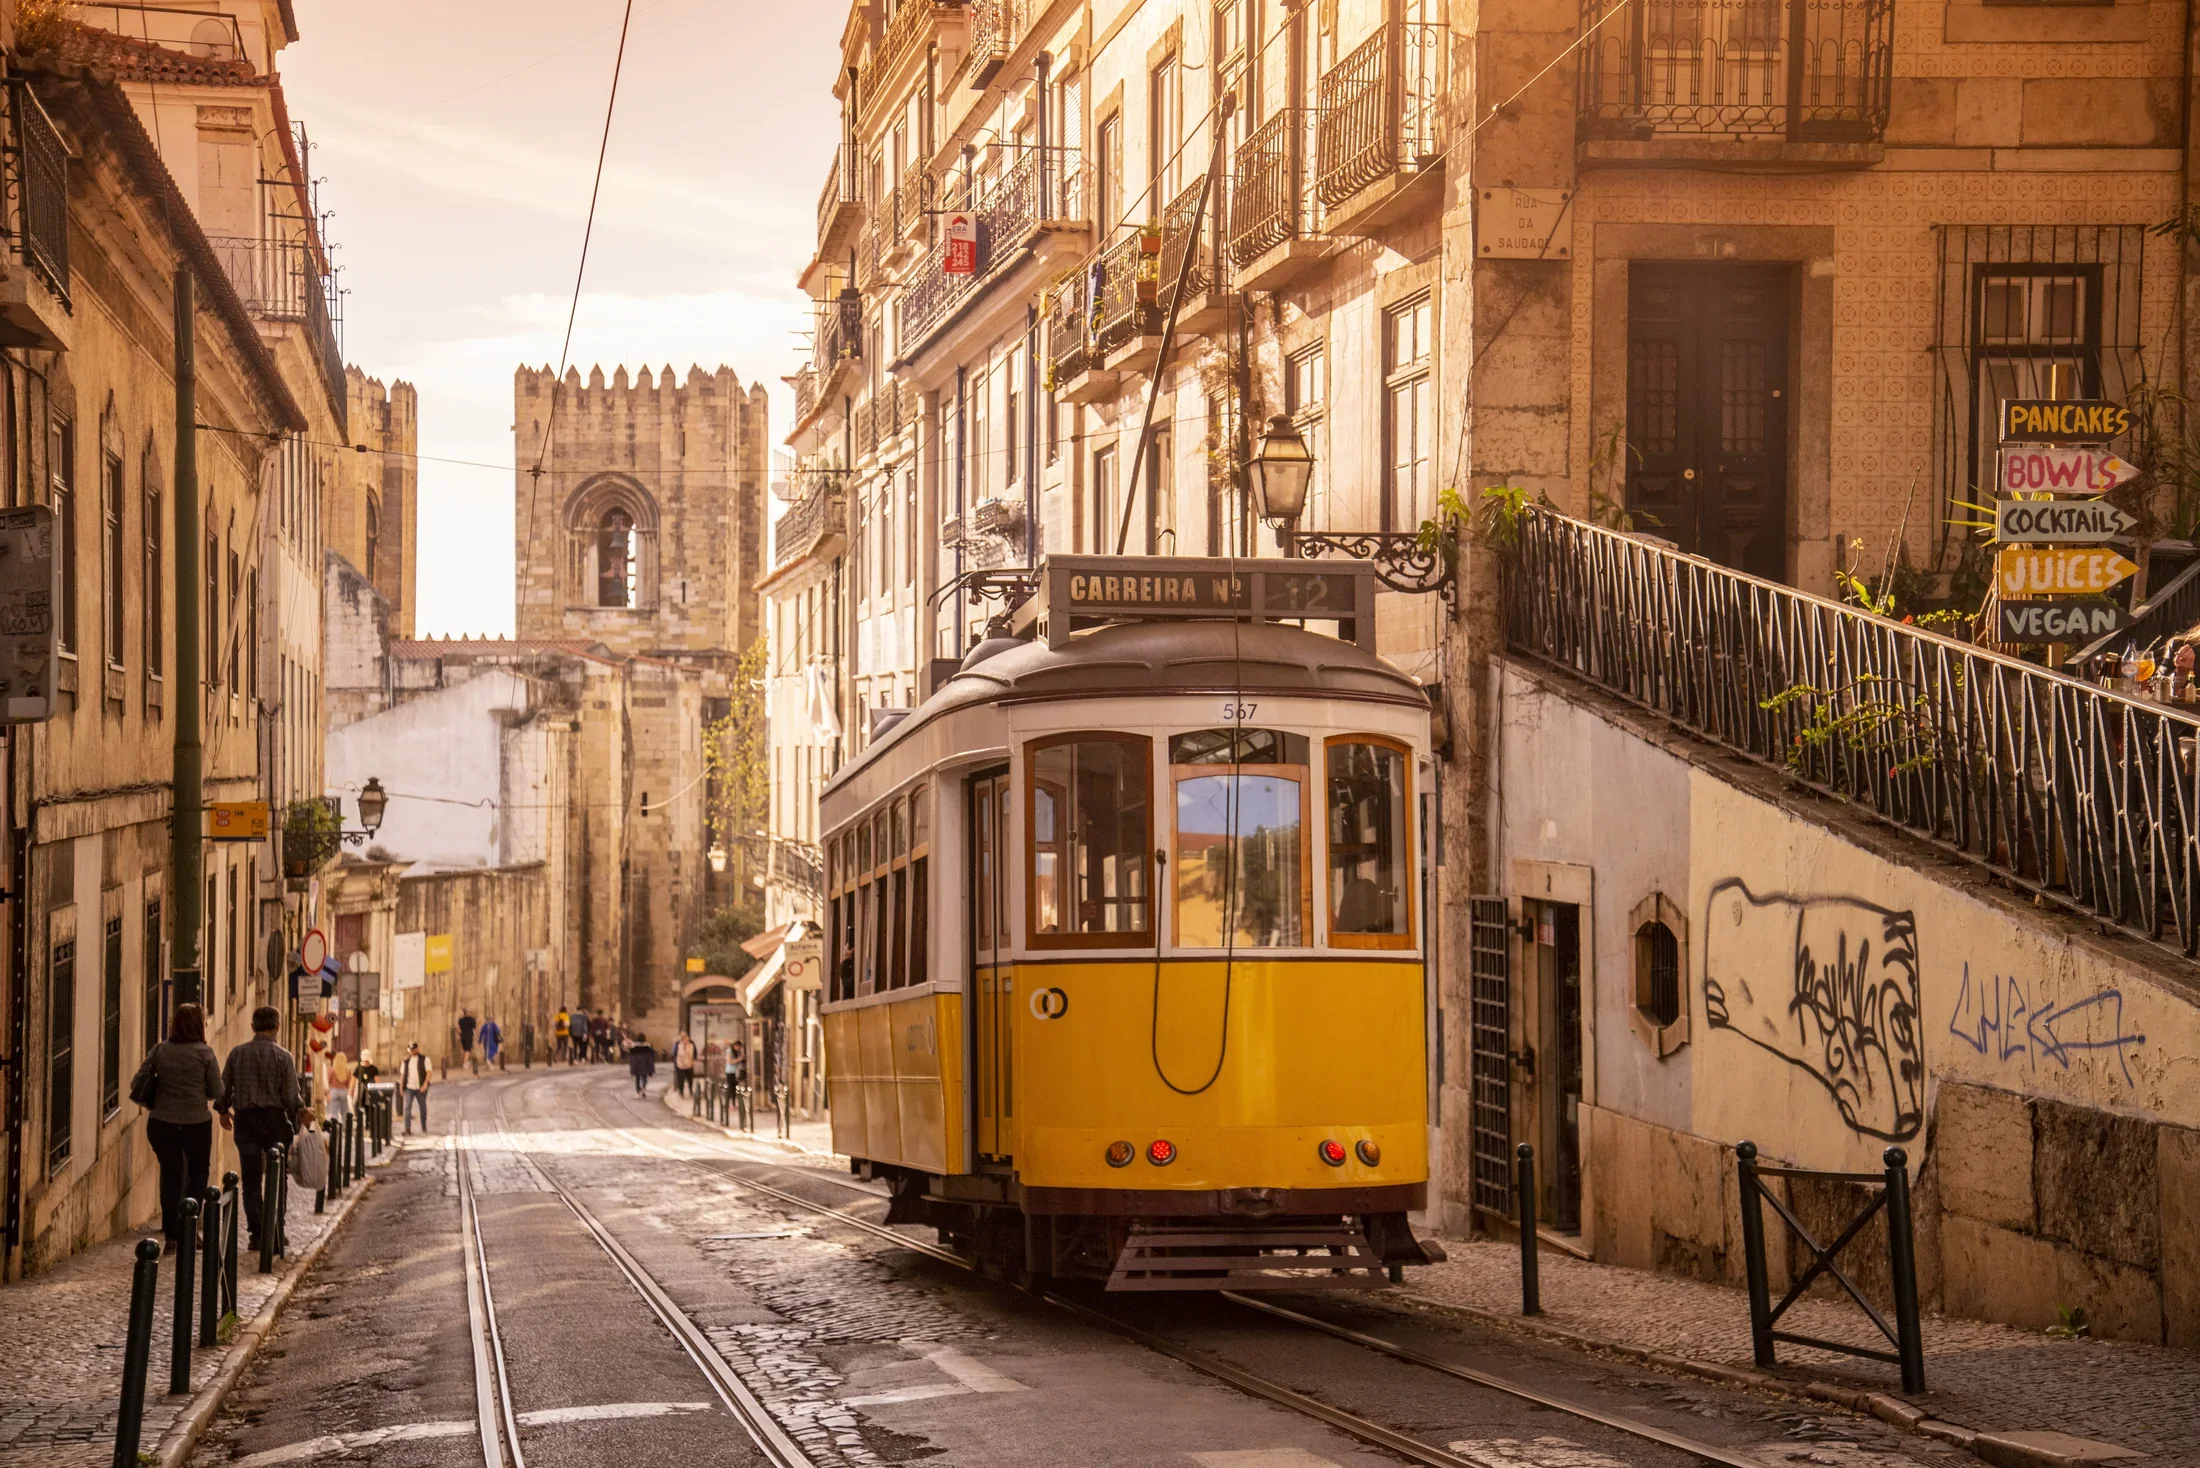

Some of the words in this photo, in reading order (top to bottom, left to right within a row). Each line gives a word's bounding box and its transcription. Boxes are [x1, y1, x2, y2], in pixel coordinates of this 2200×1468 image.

[1515, 197, 1538, 209] RUA
[1518, 217, 1534, 229] DA
[951, 242, 969, 251] 218
[1498, 237, 1551, 249] SAUDADE
[952, 250, 970, 259] 142
[951, 258, 970, 267] 245
[2010, 404, 2131, 435] PANCAKES
[2007, 454, 2118, 490] BOWLS
[1070, 575, 1197, 602] CARREIRA
[1286, 577, 1329, 611] 12
[2005, 606, 2117, 636] VEGAN
[1223, 703, 1258, 720] 567
